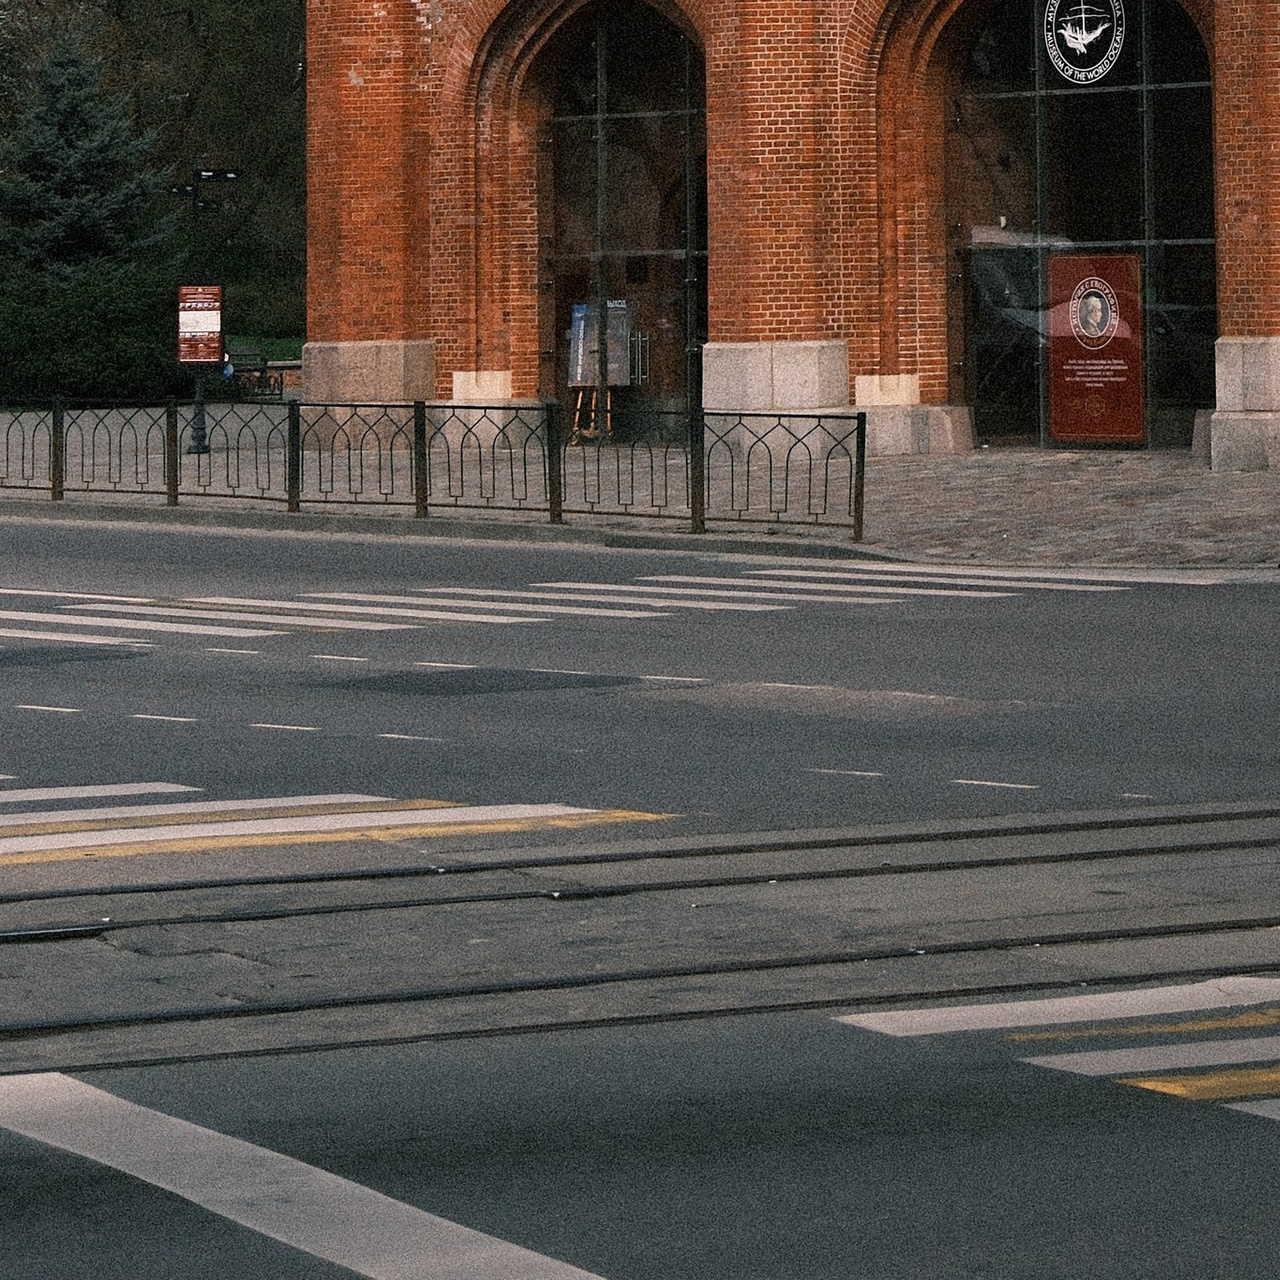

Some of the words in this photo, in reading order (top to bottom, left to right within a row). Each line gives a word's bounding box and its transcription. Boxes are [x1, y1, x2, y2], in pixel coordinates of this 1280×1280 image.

[1046, 32, 1065, 70] MUSEUM
[1064, 66, 1074, 77] OF
[1073, 71, 1086, 81] THE
[1086, 60, 1110, 78] WORLD
[1108, 26, 1123, 59] OCEAN
